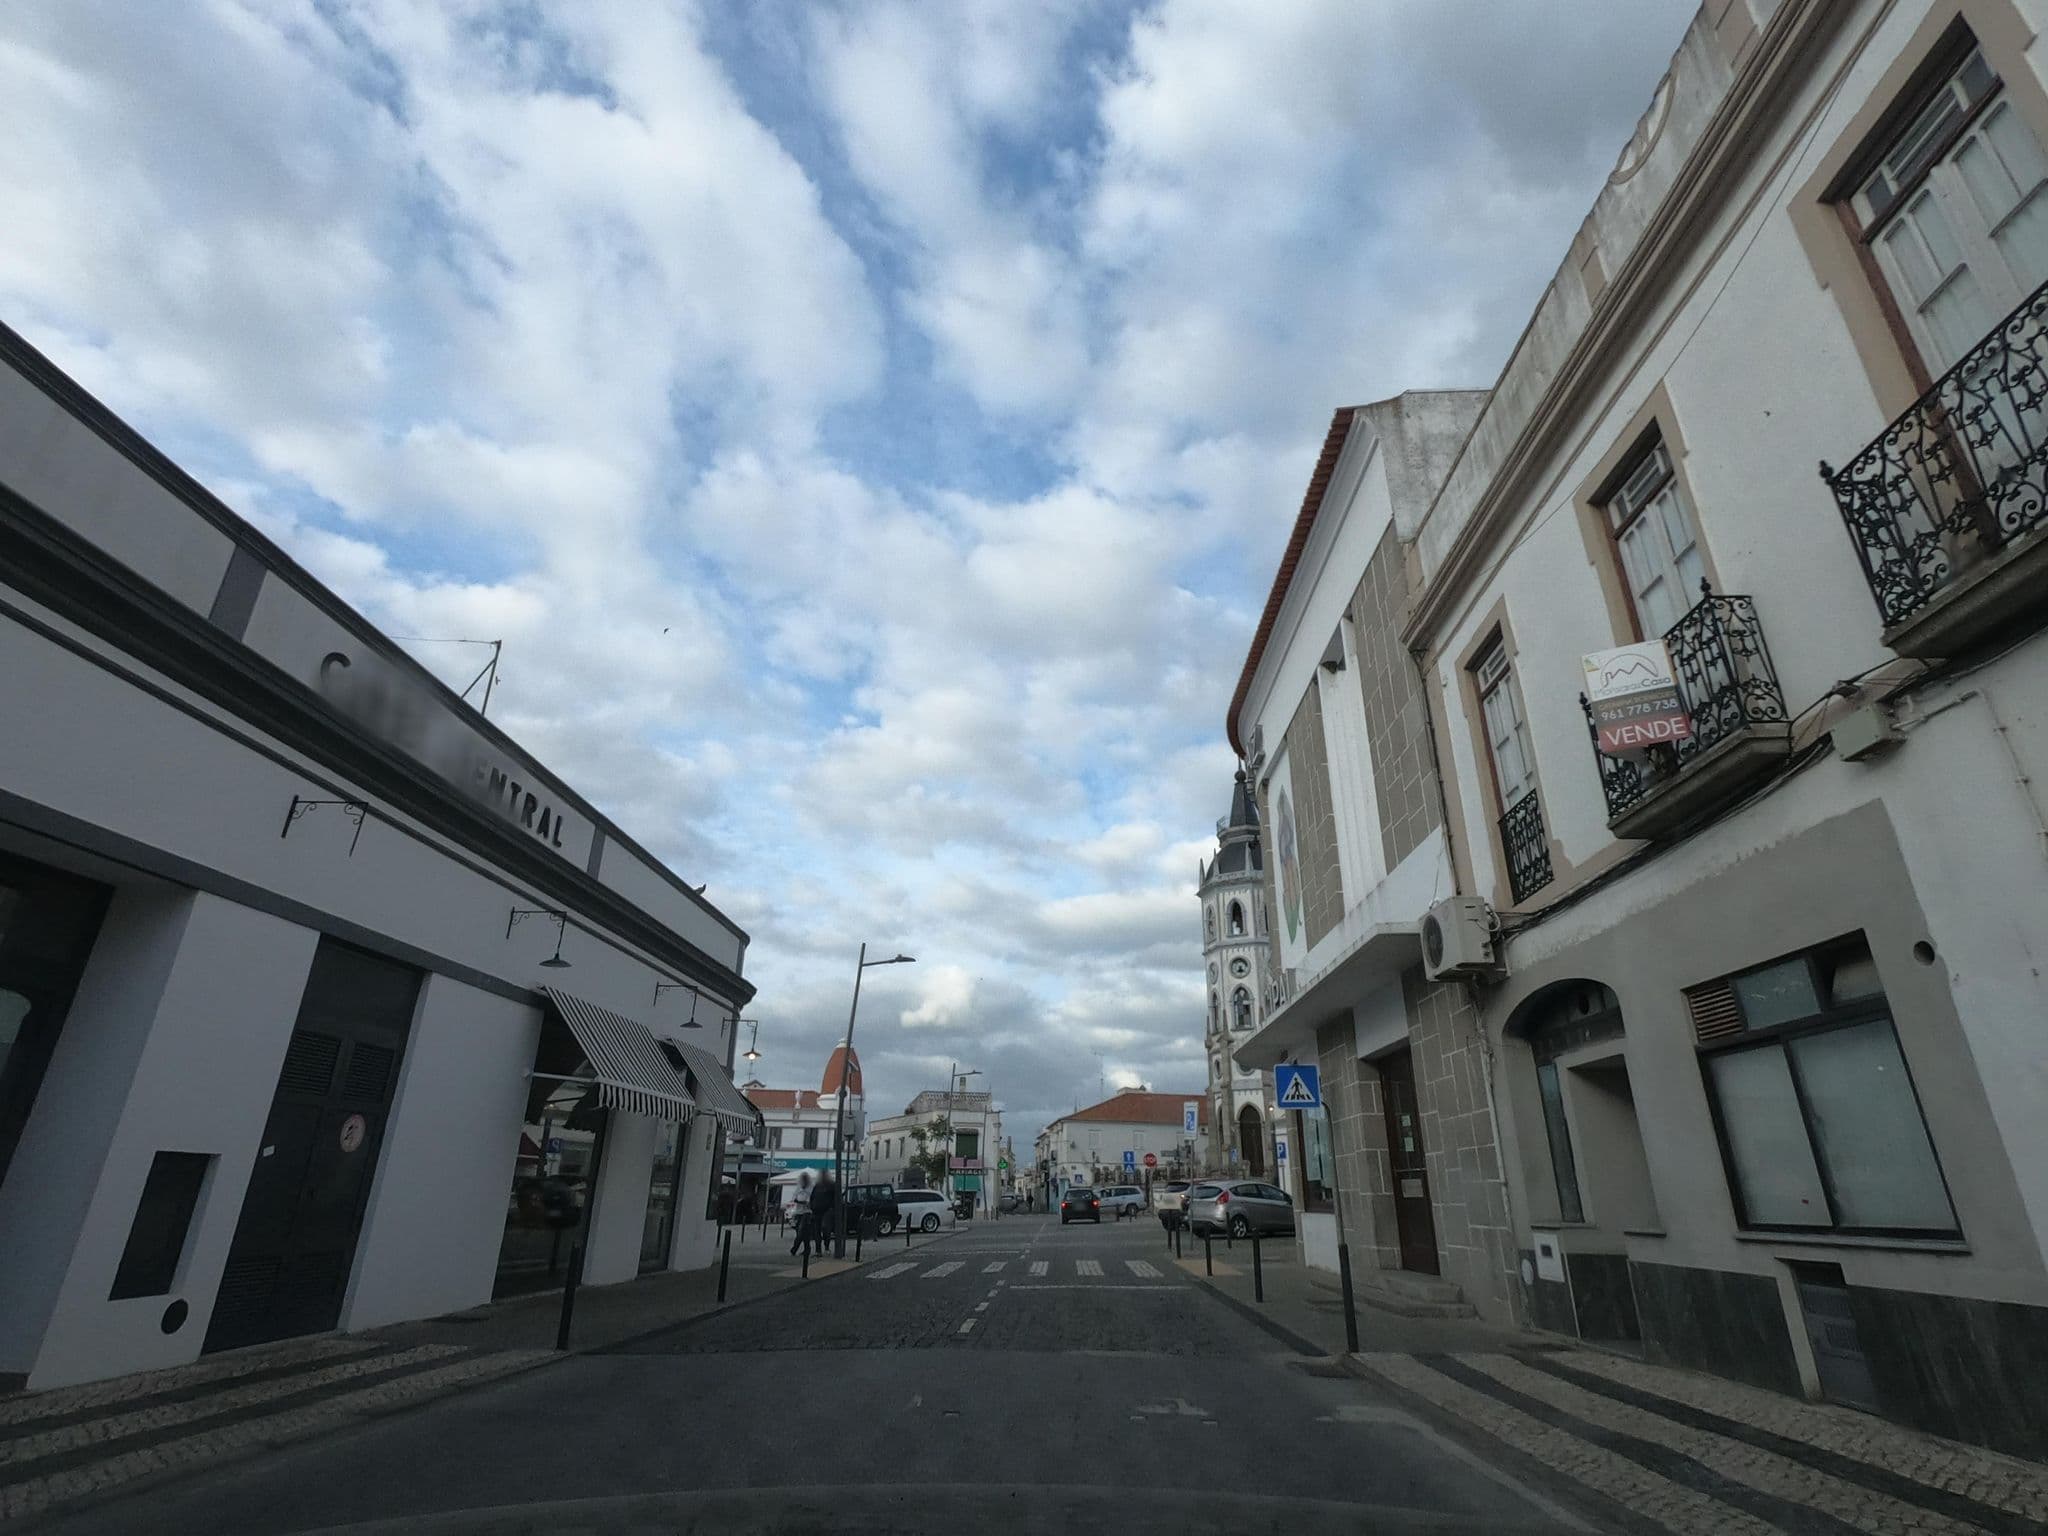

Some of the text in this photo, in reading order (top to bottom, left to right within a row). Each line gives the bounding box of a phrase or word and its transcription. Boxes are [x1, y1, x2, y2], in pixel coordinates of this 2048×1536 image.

[1605, 716, 1687, 746] VENDE
[471, 759, 562, 848] NTRAL
[1277, 1144, 1284, 1157] P
